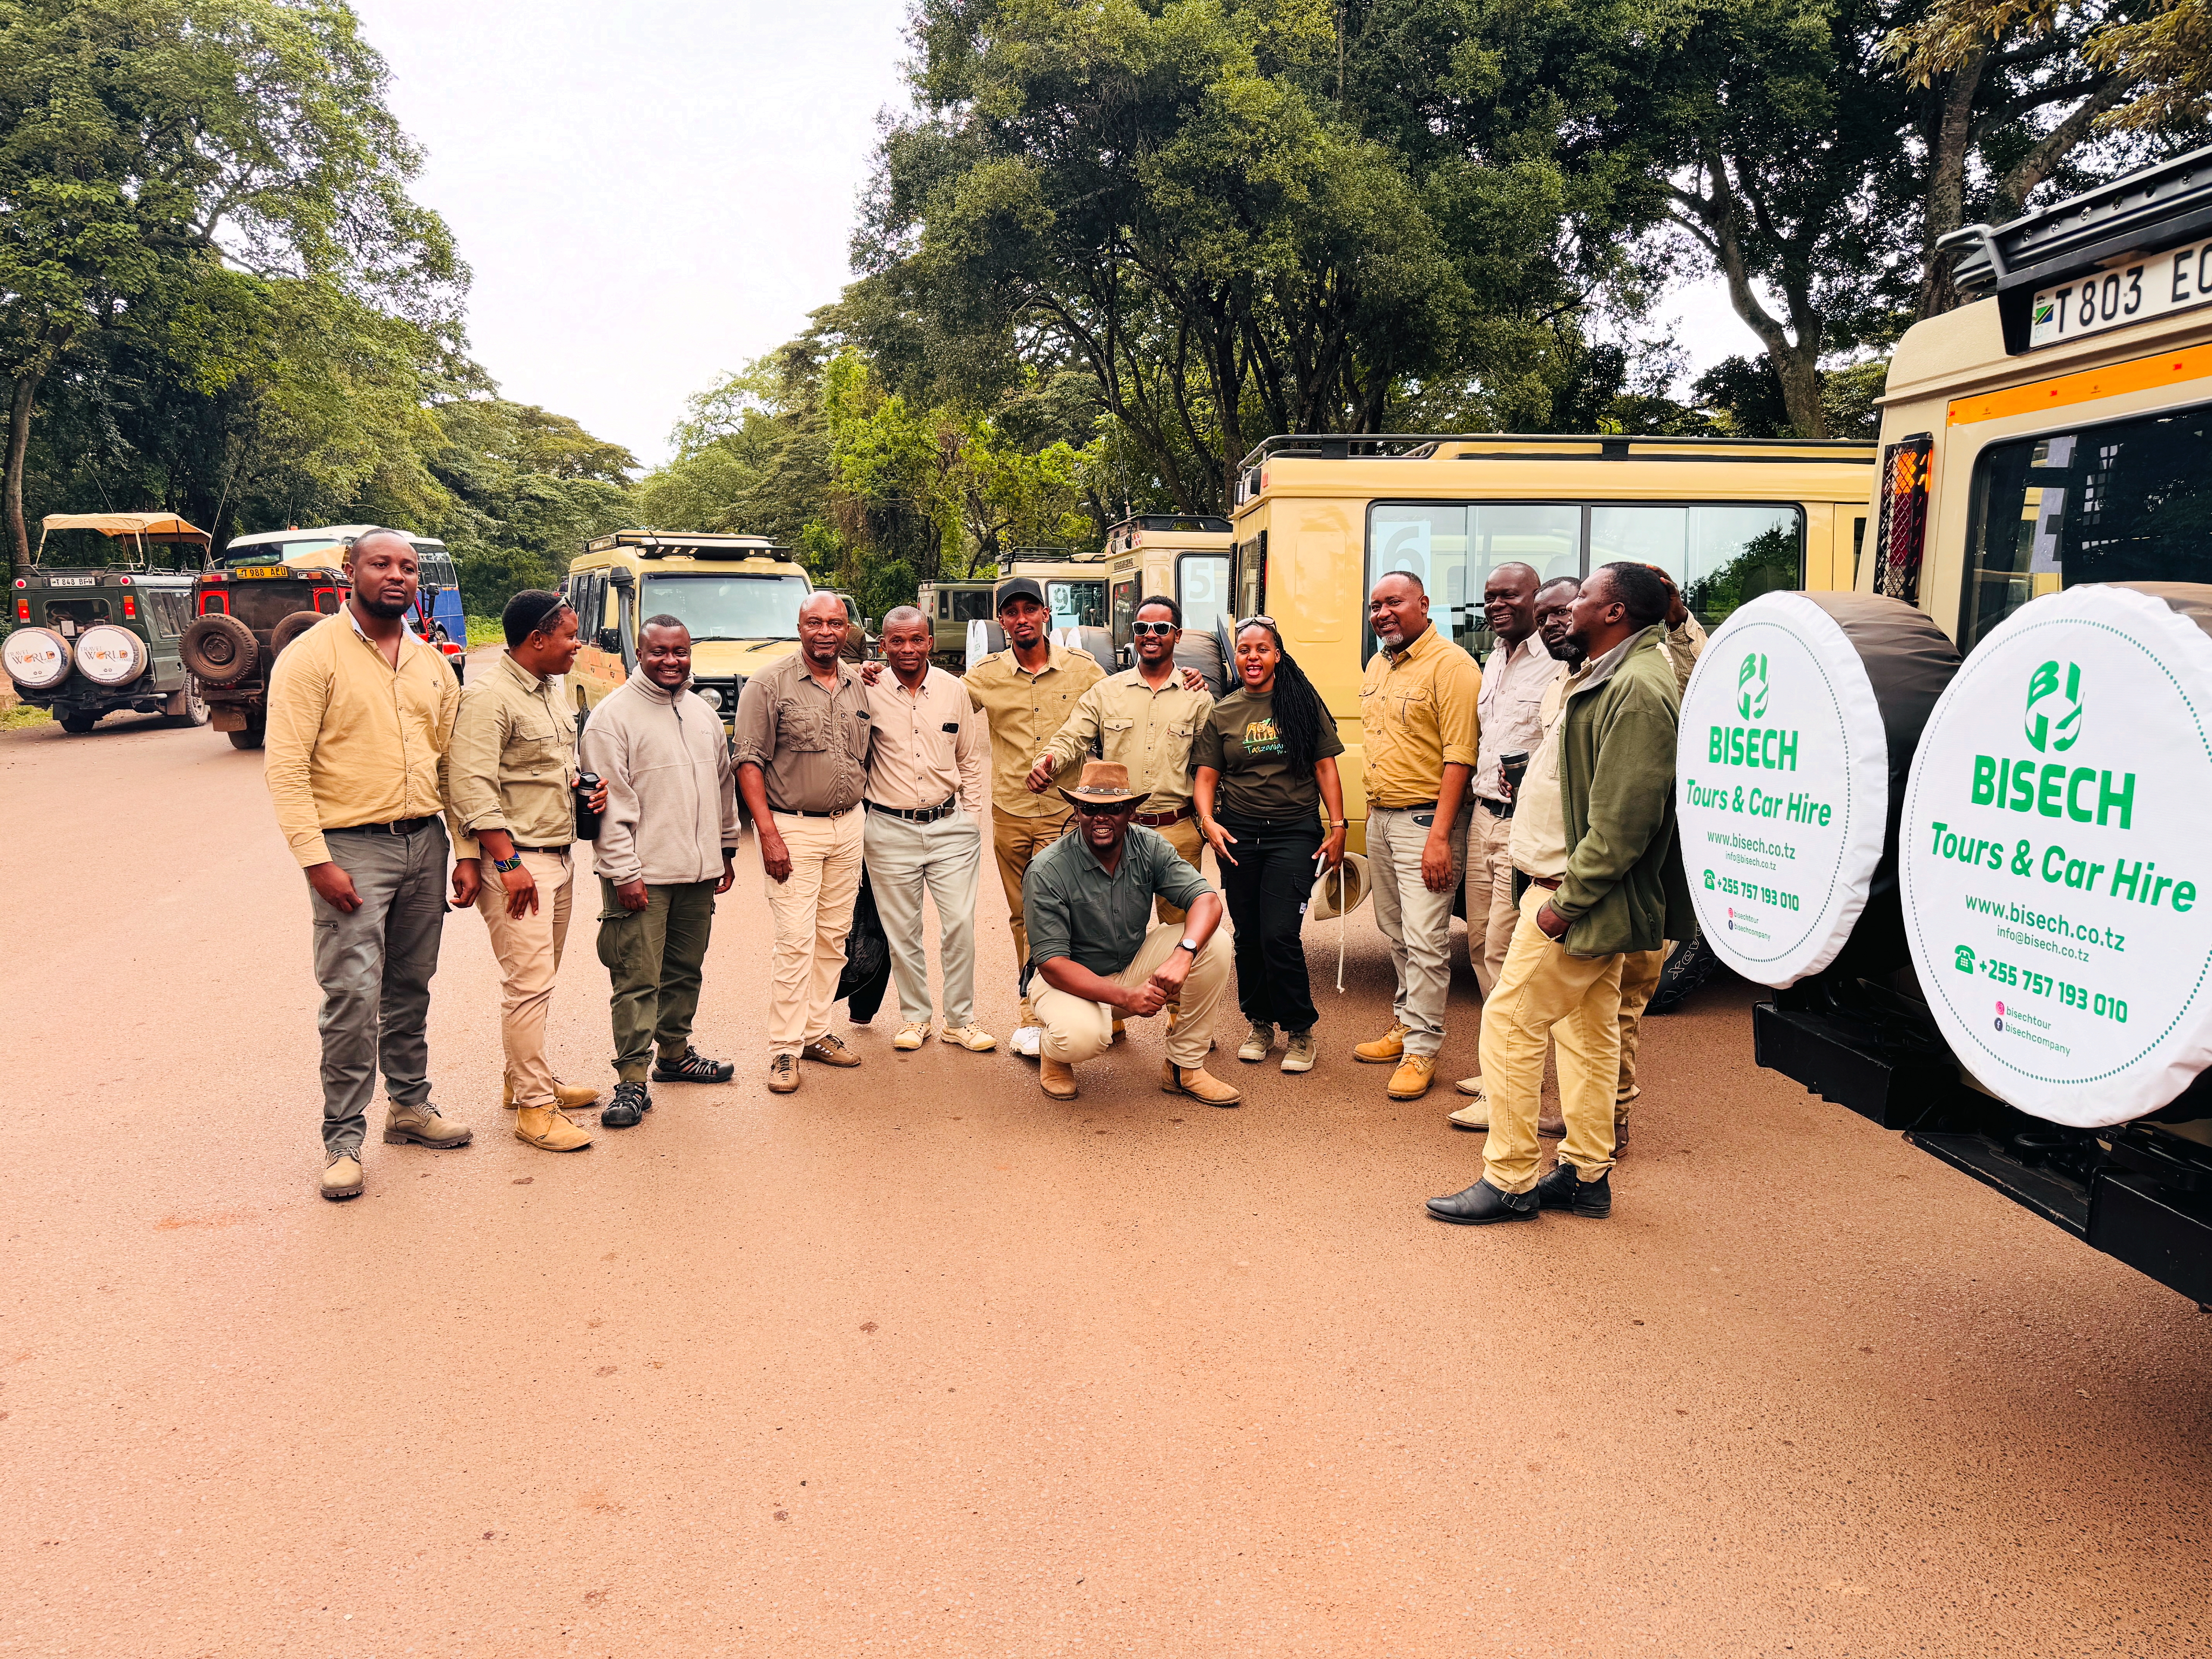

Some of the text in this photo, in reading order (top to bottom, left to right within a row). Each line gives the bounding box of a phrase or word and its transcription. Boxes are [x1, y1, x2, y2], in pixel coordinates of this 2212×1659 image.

[2055, 287, 2073, 333] T
[2079, 265, 2144, 327] 803
[1382, 525, 1425, 582] 6
[249, 568, 265, 577] 988
[1189, 562, 1211, 599] 5
[1054, 588, 1068, 611] 9
[6, 649, 30, 657] TRAVEL
[1708, 726, 1798, 771] BISECH
[1687, 779, 1832, 827] Tours & Car Hire
[1971, 754, 2136, 830] BISECH
[1707, 831, 1796, 860] www.bisech.co.tz
[1725, 851, 1776, 870] info@bisech.co.tz
[1931, 821, 2197, 913] Tours & Car Hire
[1717, 877, 1799, 912] +255 757 193 010
[1734, 909, 1759, 924] bisechtour
[1734, 921, 1771, 942] bisechcompany
[1965, 894, 2126, 952] www.bisech.co.tz
[1997, 925, 2089, 962] info@bisech.co.tz
[1979, 959, 2128, 1023] +255 757 193 010
[2006, 1006, 2052, 1030] bisechtour
[2005, 1022, 2071, 1057] bisechcompany
